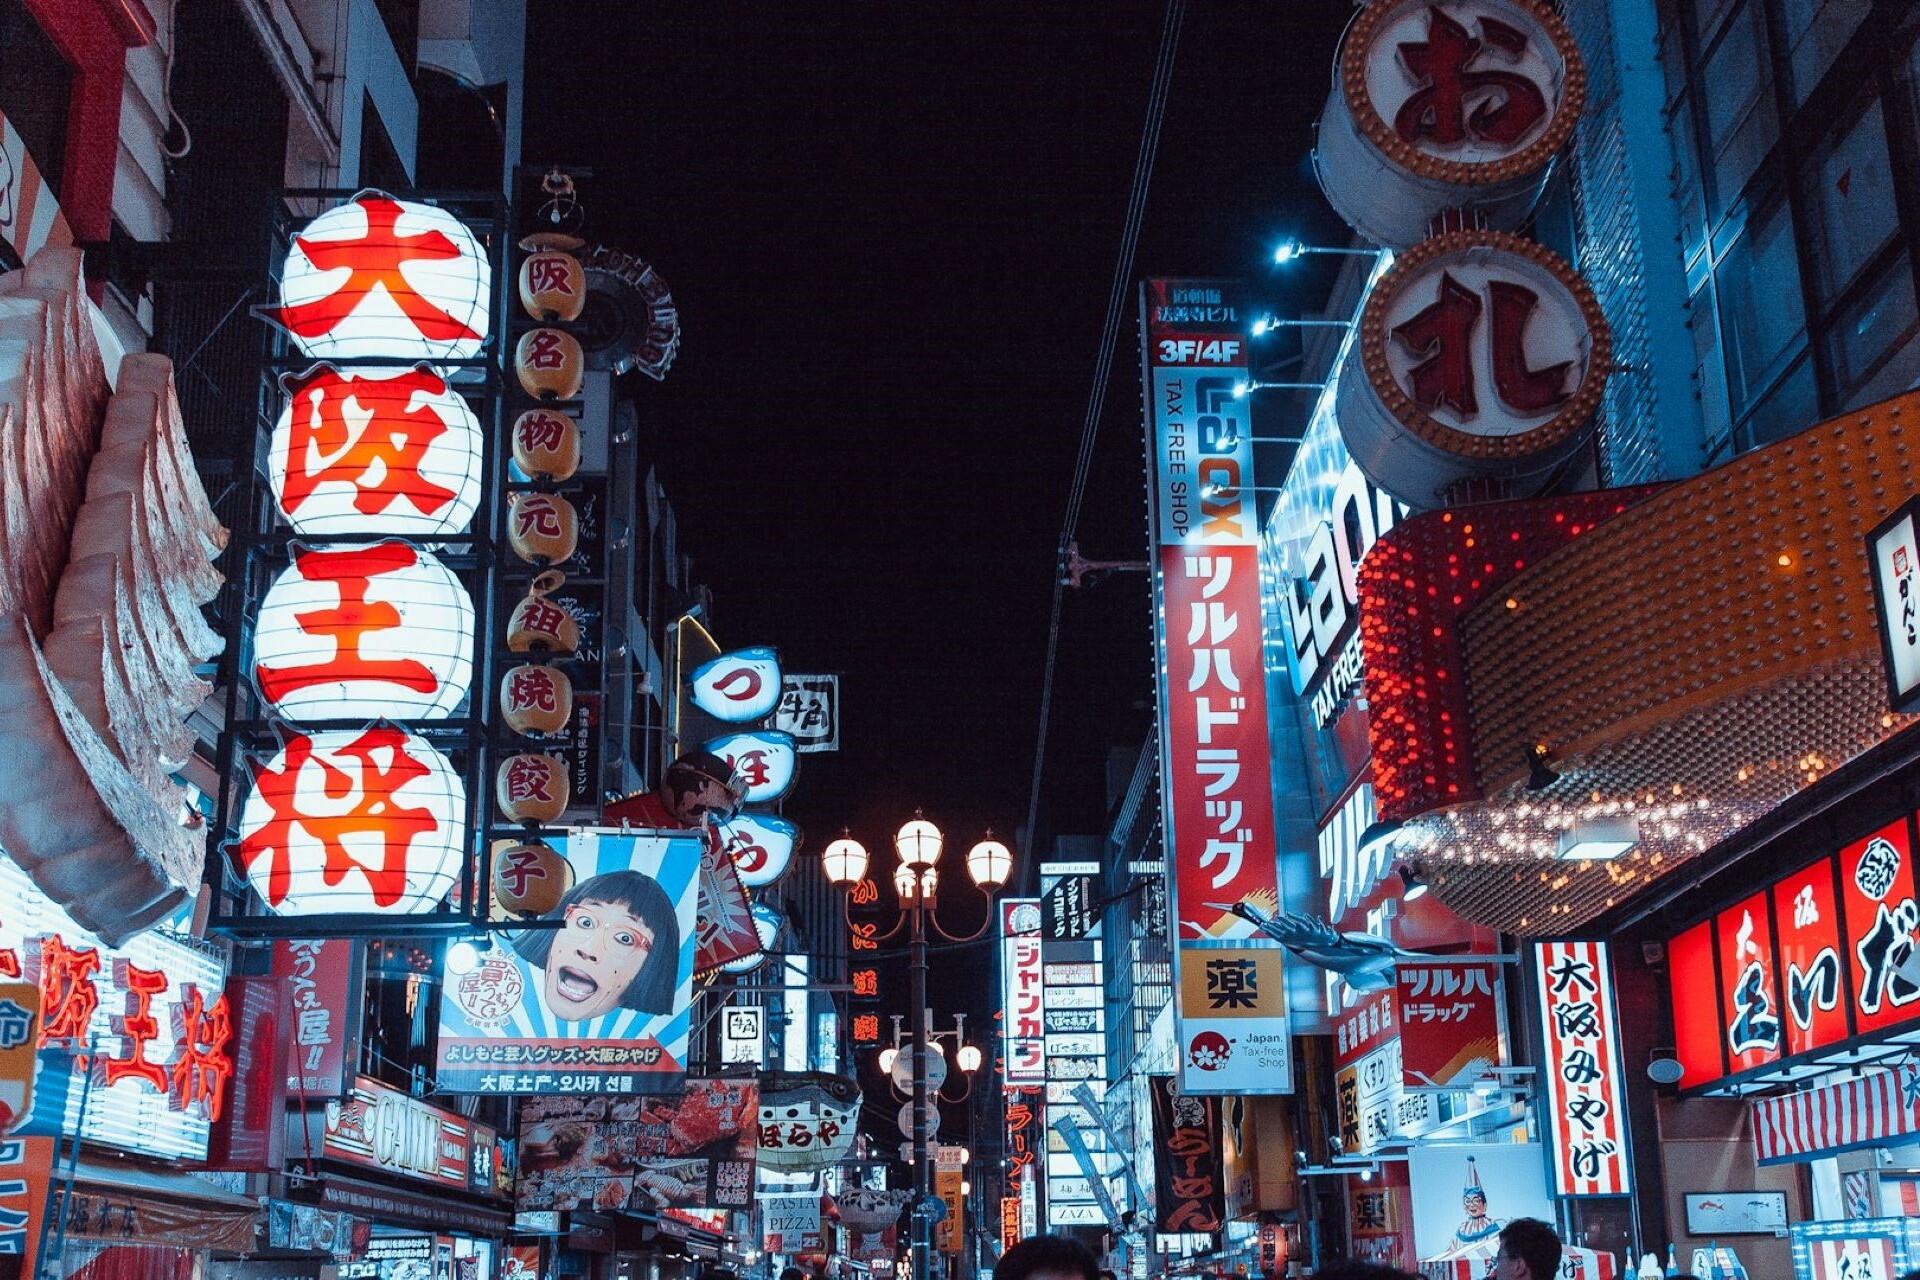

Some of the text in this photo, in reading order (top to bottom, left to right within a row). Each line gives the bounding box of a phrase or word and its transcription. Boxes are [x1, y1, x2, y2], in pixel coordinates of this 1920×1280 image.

[1173, 288, 1221, 305] 道頓堀
[1157, 306, 1238, 323] 法善寺ビル
[1159, 340, 1240, 363] 3F/4F
[1166, 379, 1189, 537] TAX FREE SHOP
[1195, 376, 1244, 539] Laox
[219, 195, 488, 908] 大阪王将
[1311, 627, 1364, 730] TAX FREE
[781, 693, 830, 731] 牛角
[1184, 555, 1254, 891] ツルハドラッグ
[1206, 958, 1258, 1009] 薬
[1401, 968, 1492, 997] ツルハ
[1017, 942, 1042, 1068] ジャンカラ
[1403, 1002, 1475, 1023] ドラッグ
[0, 933, 234, 1122] 阪王将
[1246, 1034, 1283, 1046] Japan.
[446, 1044, 660, 1065] よしもと芸人グッズ・大阪みやげ
[1242, 1046, 1285, 1057] Tax-free
[1258, 1058, 1286, 1070] Shop
[1550, 956, 1616, 1179] 大阪みやげ
[605, 1075, 633, 1092] 선물
[1364, 1057, 1385, 1089] くすり
[1340, 1076, 1360, 1146] 薬
[757, 1120, 840, 1149] ぼらや
[1006, 1105, 1034, 1191] ラーメ
[1166, 1127, 1218, 1232] らーめん
[768, 1197, 817, 1210] PASTA
[769, 1216, 817, 1230] PIZZA
